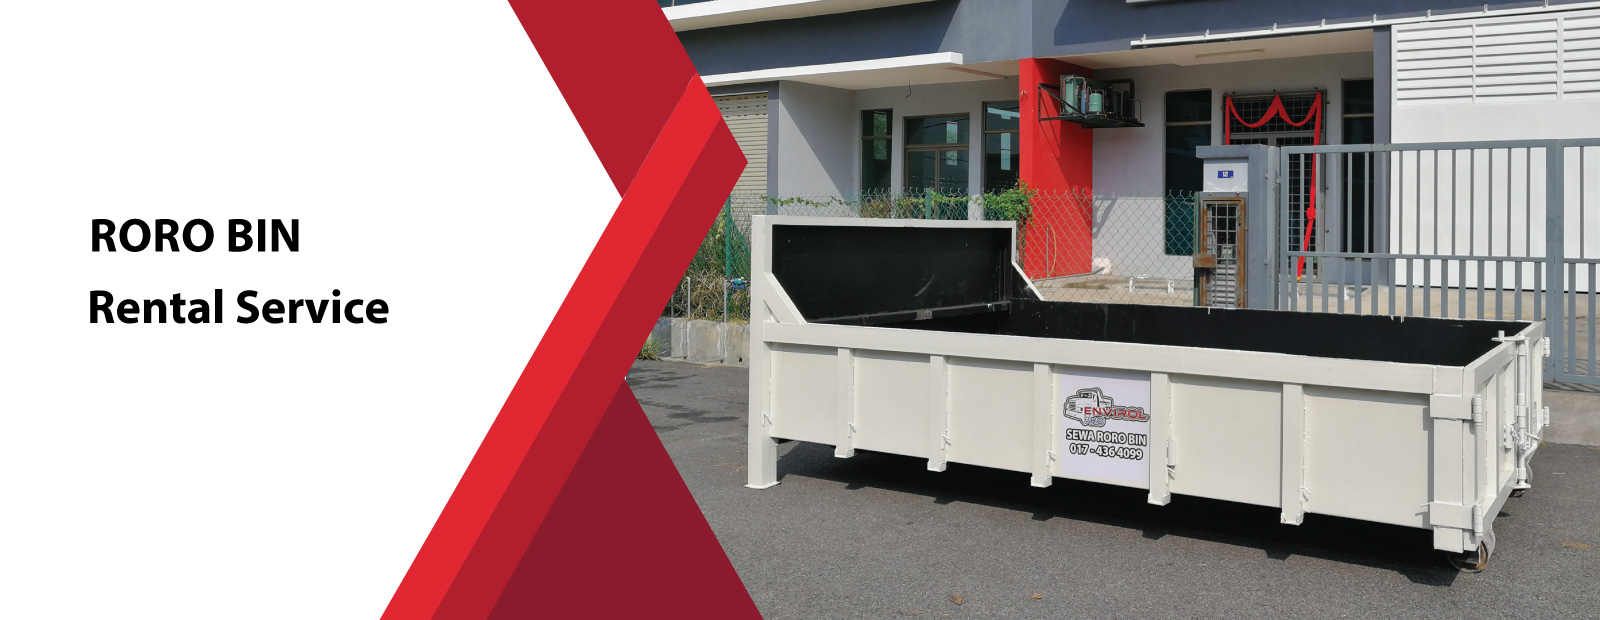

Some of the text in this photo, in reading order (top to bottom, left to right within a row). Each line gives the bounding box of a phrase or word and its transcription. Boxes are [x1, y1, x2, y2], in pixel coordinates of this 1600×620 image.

[1084, 407, 1147, 419] ENVIROL
[1066, 428, 1147, 447] SEWA RORO BIN
[1069, 443, 1089, 455] 017
[1096, 445, 1115, 458] 436
[1116, 447, 1143, 460] 4099
